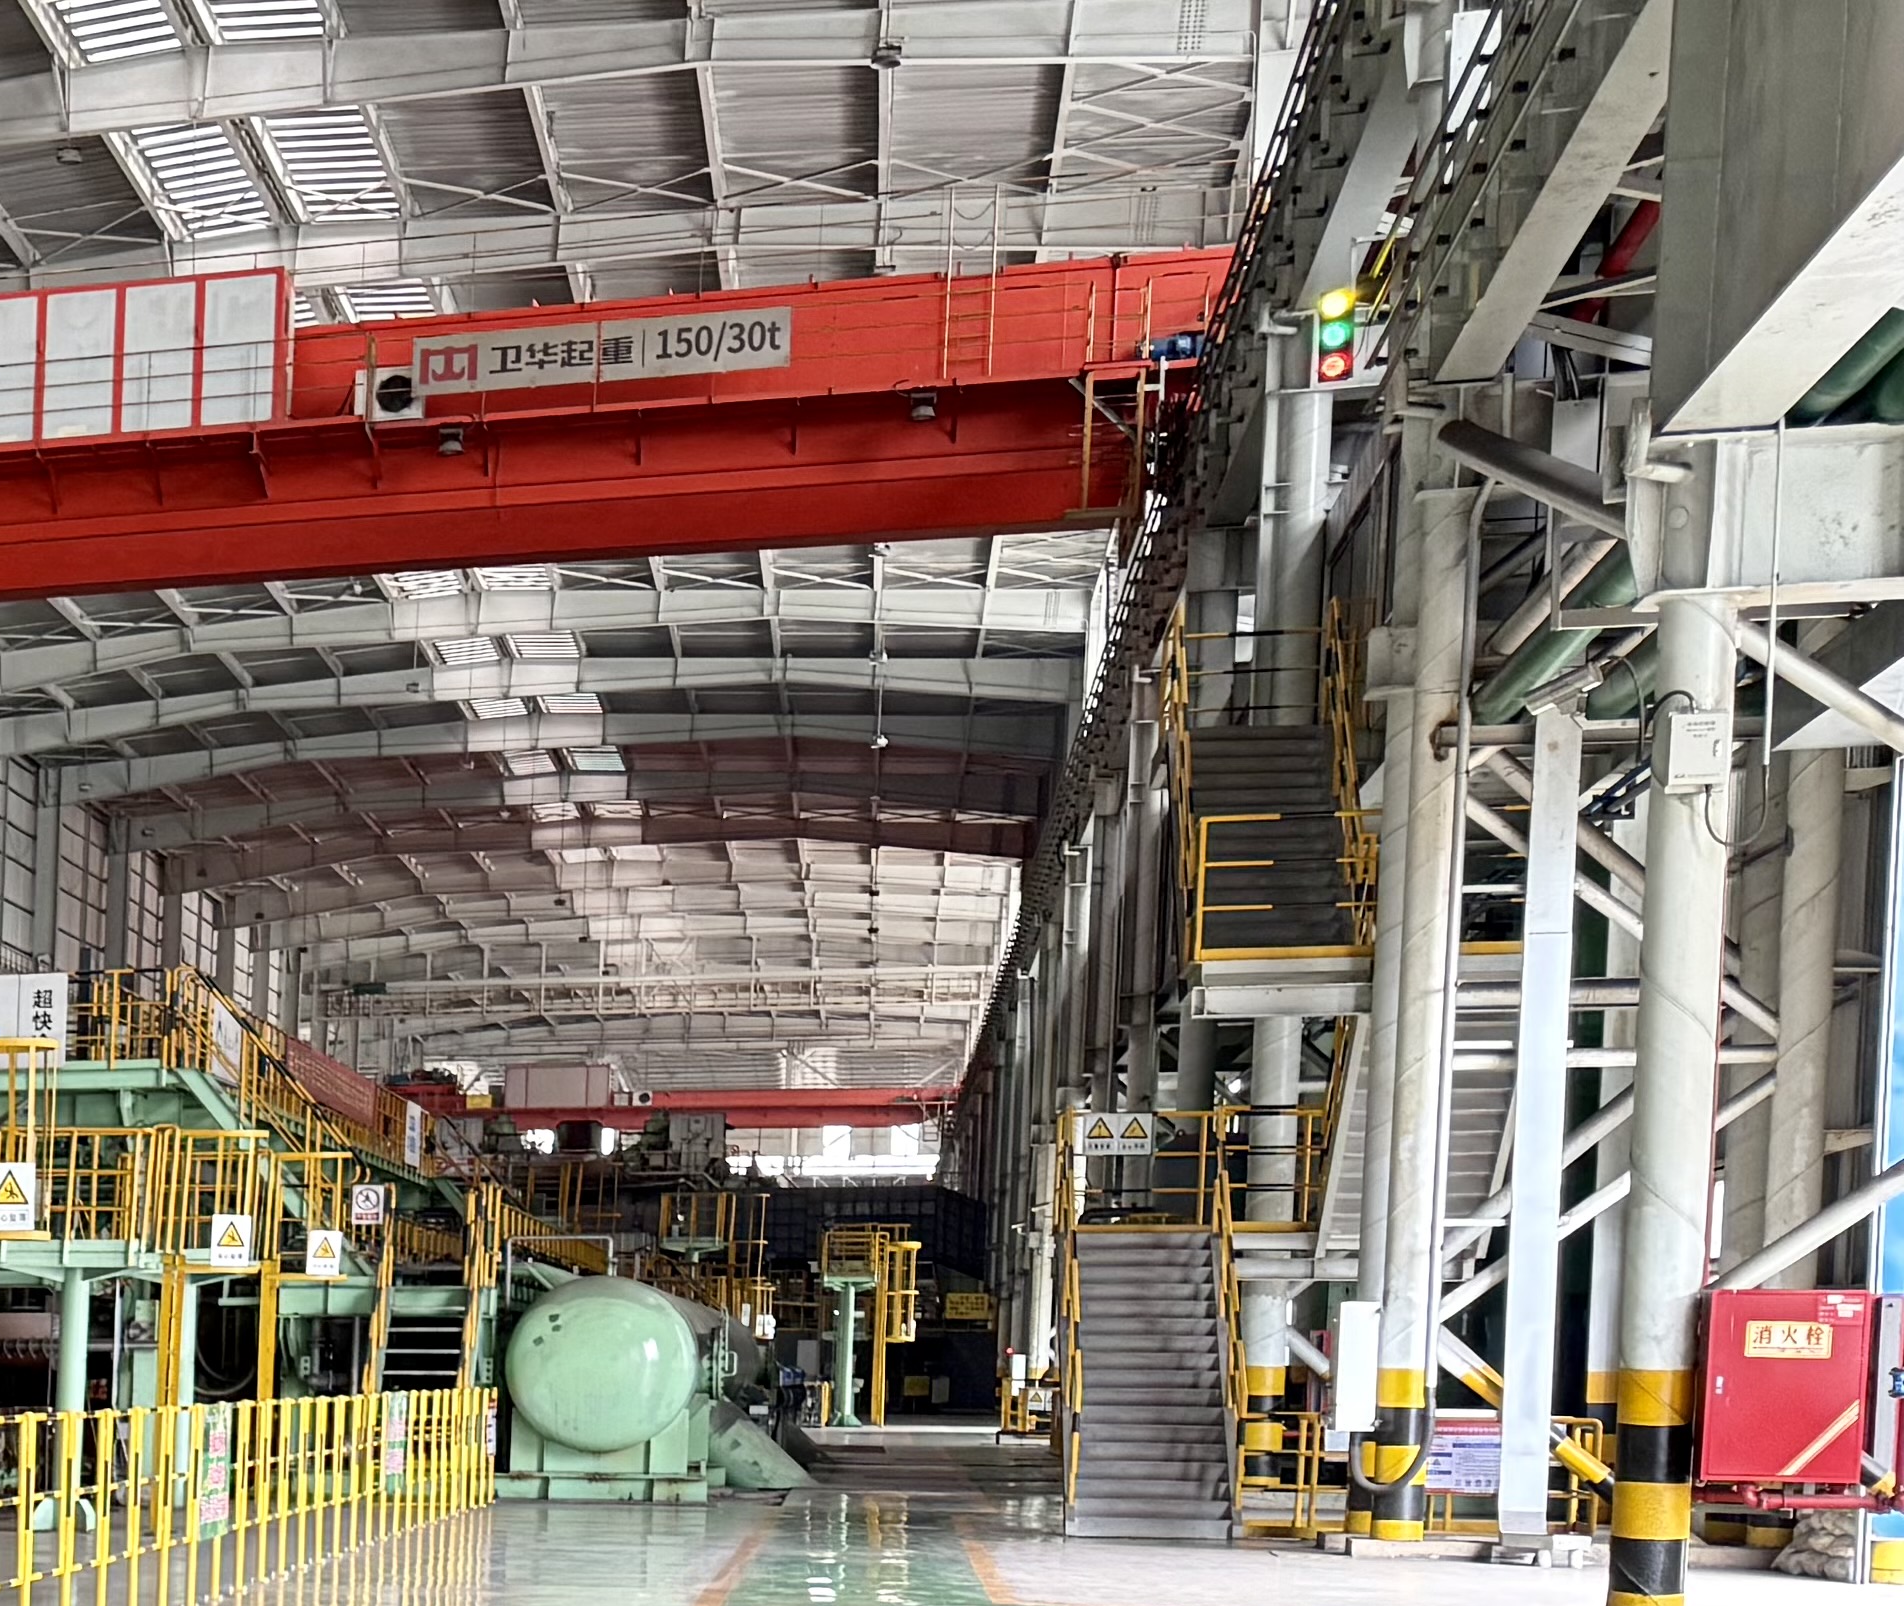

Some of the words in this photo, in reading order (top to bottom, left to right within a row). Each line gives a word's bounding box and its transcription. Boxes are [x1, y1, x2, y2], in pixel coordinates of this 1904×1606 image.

[489, 336, 634, 375] 卫华起重
[656, 320, 782, 362] 150/30t
[32, 989, 53, 1037] 超快
[1752, 1325, 1825, 1345] 消火栓
